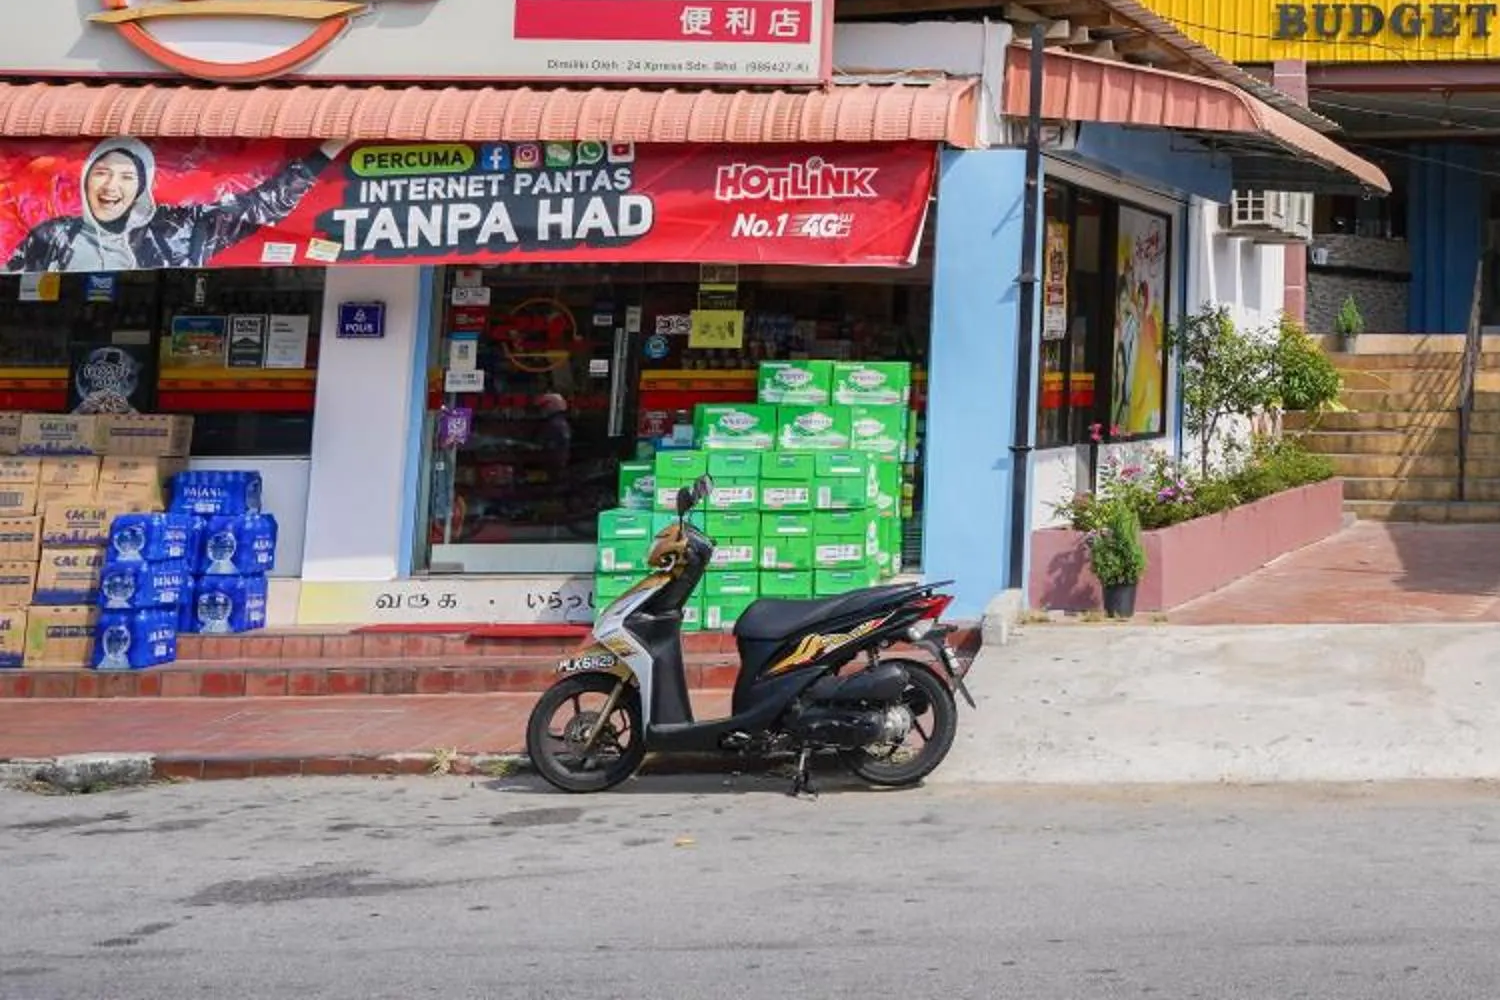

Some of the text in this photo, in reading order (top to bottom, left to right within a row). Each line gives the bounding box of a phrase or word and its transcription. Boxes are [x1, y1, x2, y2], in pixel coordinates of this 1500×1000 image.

[680, 5, 801, 37] 便利店
[1276, 3, 1497, 40] BUDGET
[363, 149, 465, 169] PERCUMA
[359, 168, 632, 203] INTERNET PANTAS
[333, 194, 653, 251] TANPA HAD
[731, 212, 789, 238] No.1
[345, 323, 373, 333] POLIS
